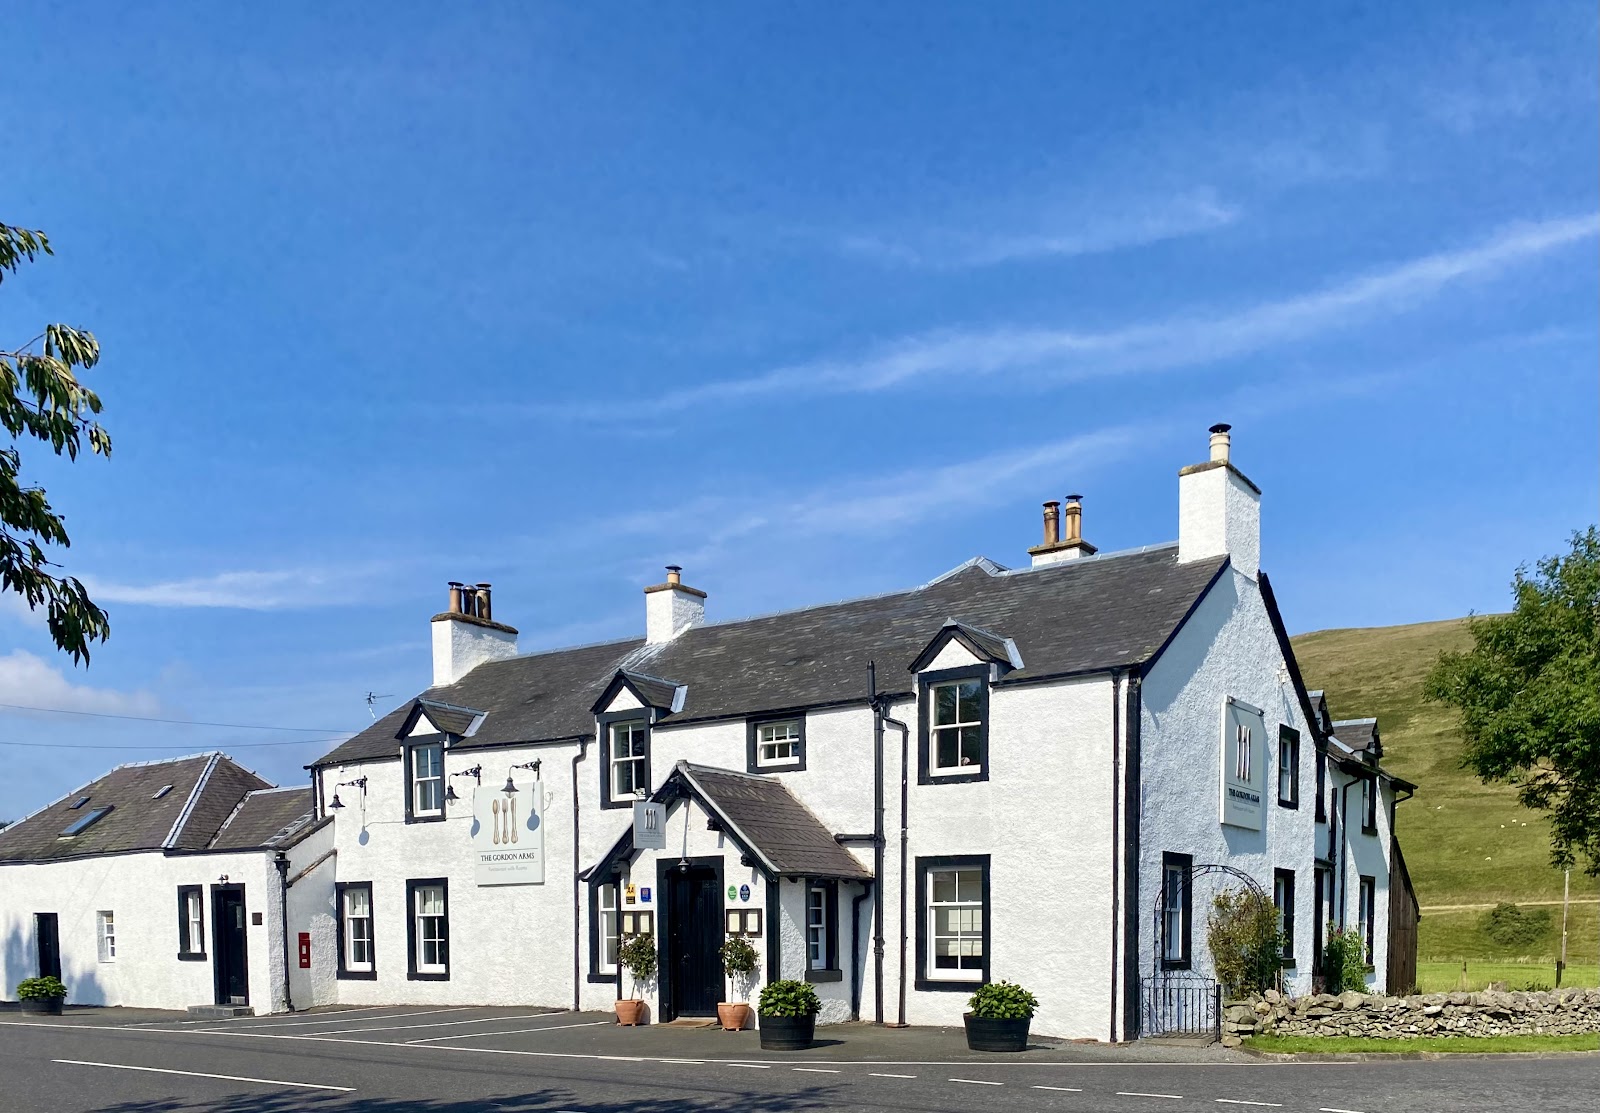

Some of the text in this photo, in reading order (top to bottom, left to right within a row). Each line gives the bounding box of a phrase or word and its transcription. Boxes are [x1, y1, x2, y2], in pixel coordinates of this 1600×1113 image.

[1228, 787, 1236, 797] THE
[492, 853, 518, 861] GORDON
[518, 852, 535, 860] ARMS
